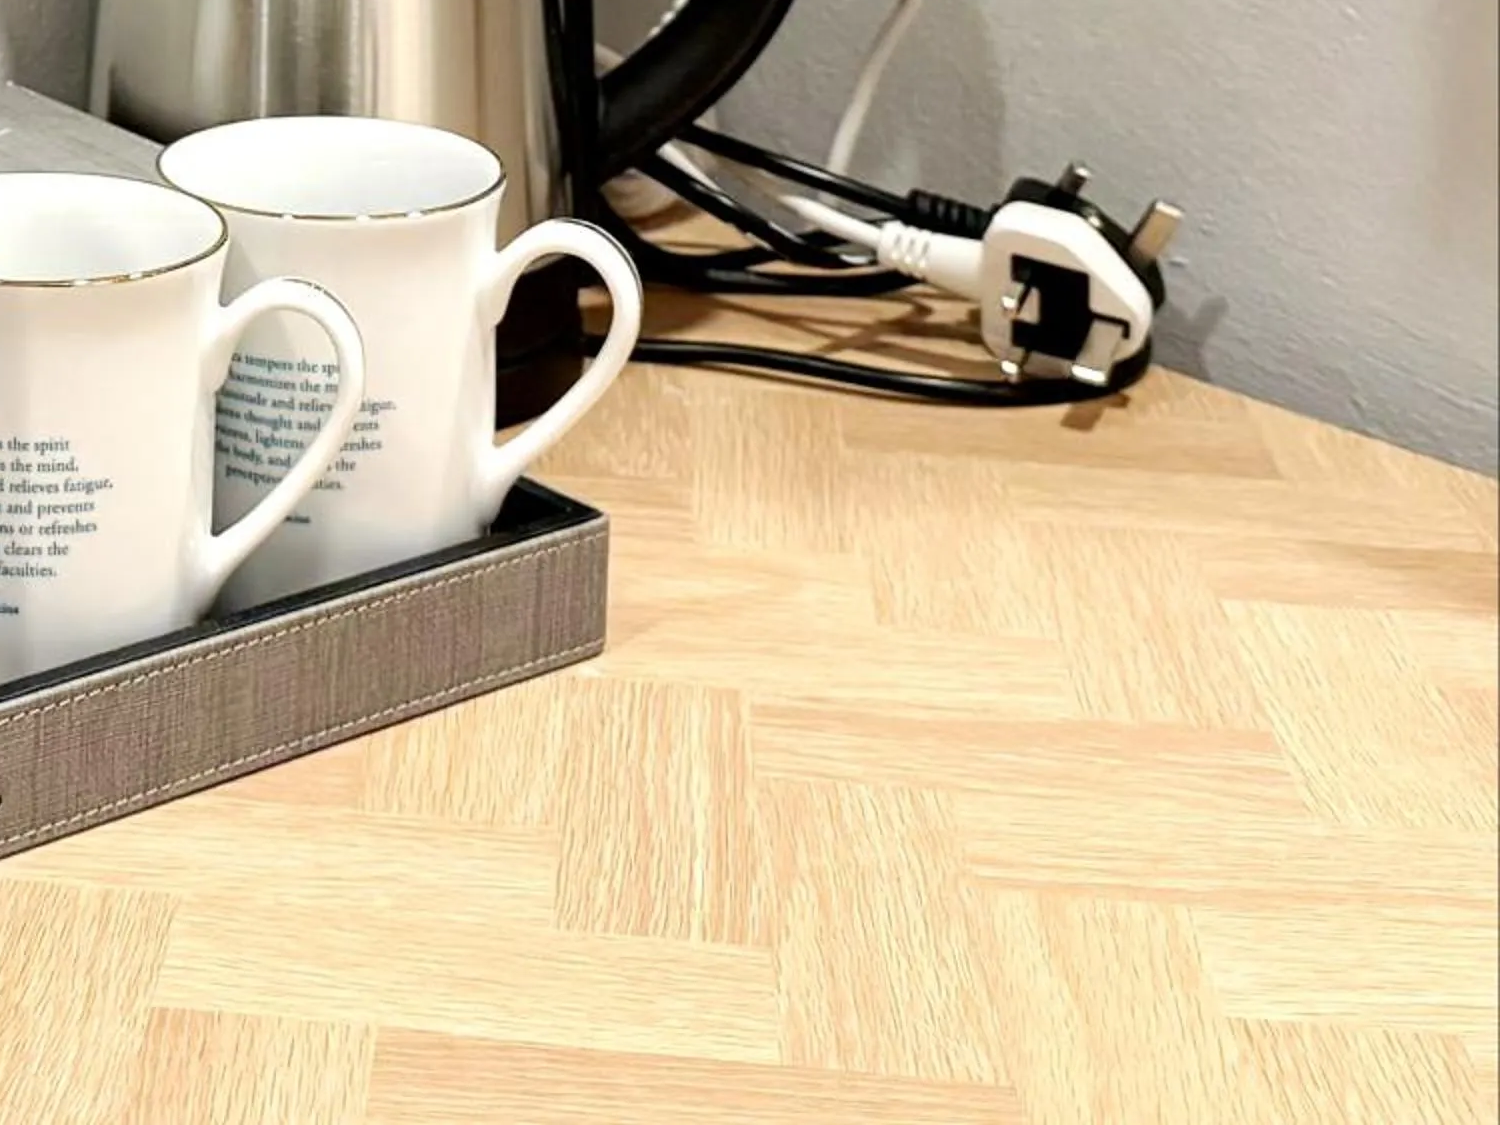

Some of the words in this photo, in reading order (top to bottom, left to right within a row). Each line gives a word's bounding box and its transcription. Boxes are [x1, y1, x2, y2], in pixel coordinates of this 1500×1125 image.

[297, 358, 319, 373] the
[300, 380, 320, 393] the
[271, 398, 295, 411] and
[299, 397, 334, 412] reliev
[297, 419, 321, 432] and
[8, 437, 30, 452] the
[34, 438, 70, 456] spirit
[10, 457, 33, 473] the
[268, 455, 291, 466] and
[335, 459, 356, 471] the
[8, 479, 59, 494] relieves
[6, 499, 33, 515] and
[37, 501, 95, 519] prevents
[19, 523, 33, 535] or
[38, 519, 98, 536] refreshes
[4, 540, 43, 556] clears
[47, 541, 69, 556] the
